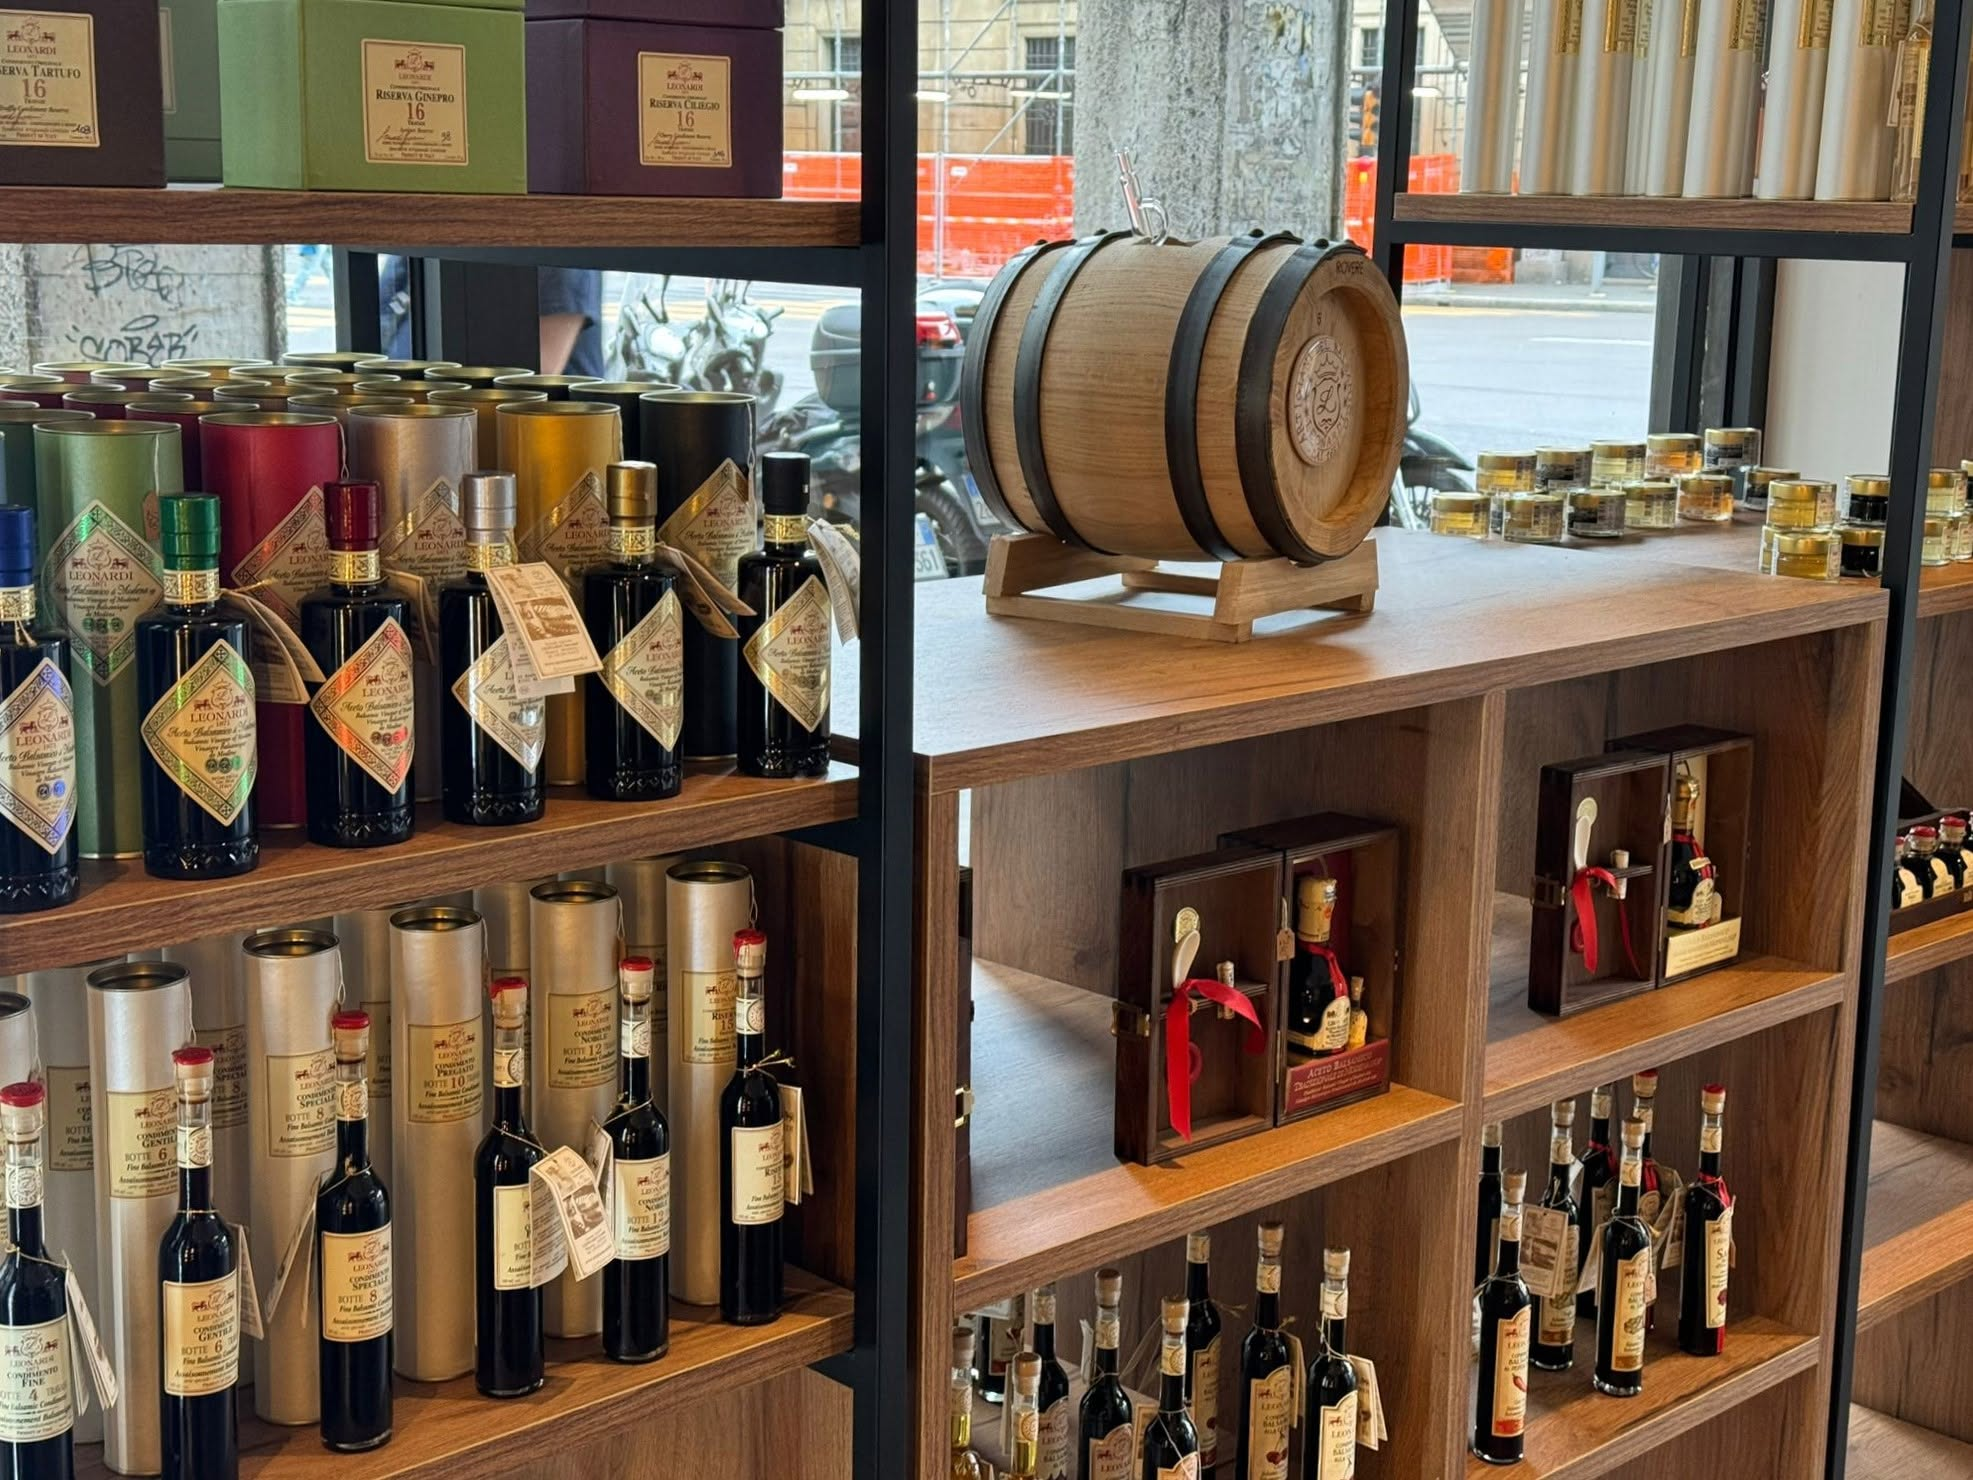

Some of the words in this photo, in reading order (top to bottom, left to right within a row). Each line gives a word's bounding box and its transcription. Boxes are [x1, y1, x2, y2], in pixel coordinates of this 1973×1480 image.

[7, 45, 56, 55] LEONARDI
[31, 64, 81, 79] TARTUFO
[23, 79, 46, 98] 16
[667, 82, 703, 91] LEONARDI
[376, 89, 413, 101] RISERVA
[415, 91, 455, 103] GINEPRO
[407, 102, 426, 120] 16
[650, 98, 682, 110] RISERVA
[684, 100, 720, 111] CILIEGIO
[677, 111, 695, 128] 16
[1336, 261, 1363, 275] ROVERE
[70, 571, 133, 581] LEONARDI
[589, 1044, 602, 1056] 12
[437, 1064, 475, 1078] PREGIATO
[451, 1077, 465, 1089] 10
[316, 1107, 324, 1120] 8
[125, 1152, 151, 1162] BOTTE
[158, 1148, 167, 1161] 6
[369, 1289, 377, 1303] 8
[198, 1326, 234, 1342] GENTILE
[182, 1345, 208, 1356] BOTTE
[214, 1340, 223, 1354] 6
[7, 1366, 58, 1380] CONDIMENTO
[22, 1378, 46, 1388] FINE
[28, 1388, 39, 1402] 4
